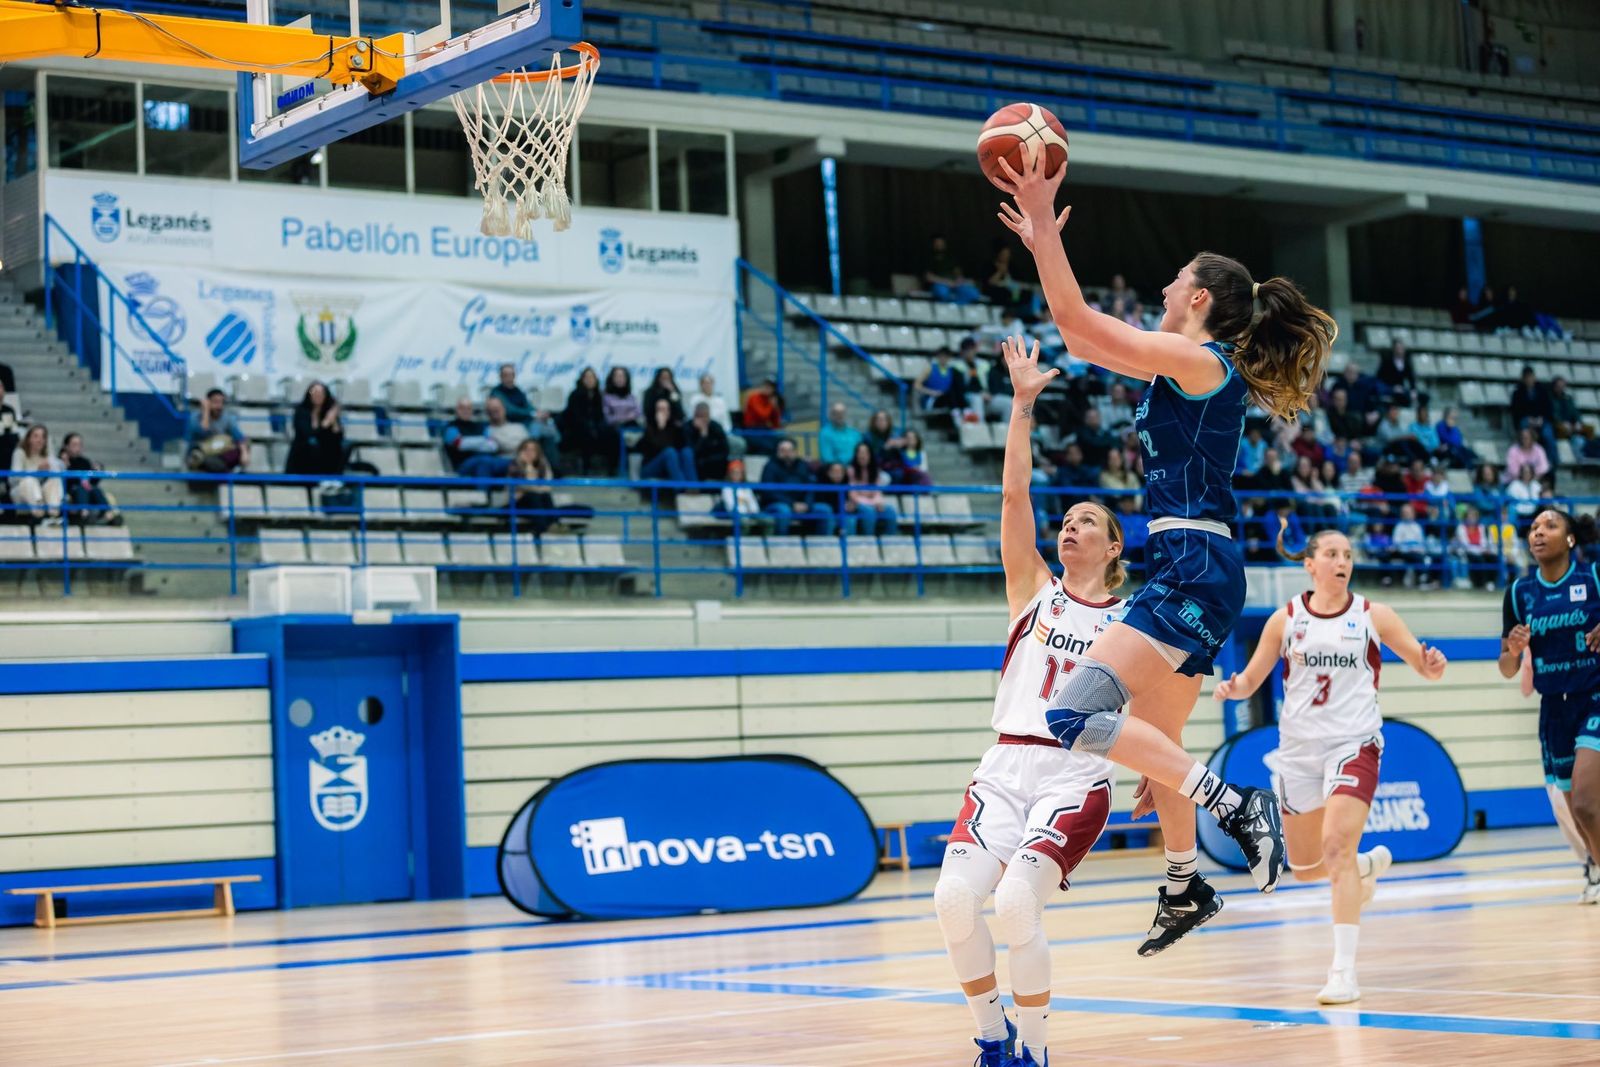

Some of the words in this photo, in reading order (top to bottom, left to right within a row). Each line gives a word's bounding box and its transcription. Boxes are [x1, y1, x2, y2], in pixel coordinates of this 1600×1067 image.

[126, 207, 212, 233] Leganés
[281, 217, 420, 256] Pabellón
[431, 226, 540, 267] Europa
[627, 241, 698, 264] Leganés
[459, 294, 556, 345] Gracias
[1311, 671, 1332, 707] 3
[569, 816, 836, 876] innova-tsn
[1034, 827, 1062, 841] CORREO
